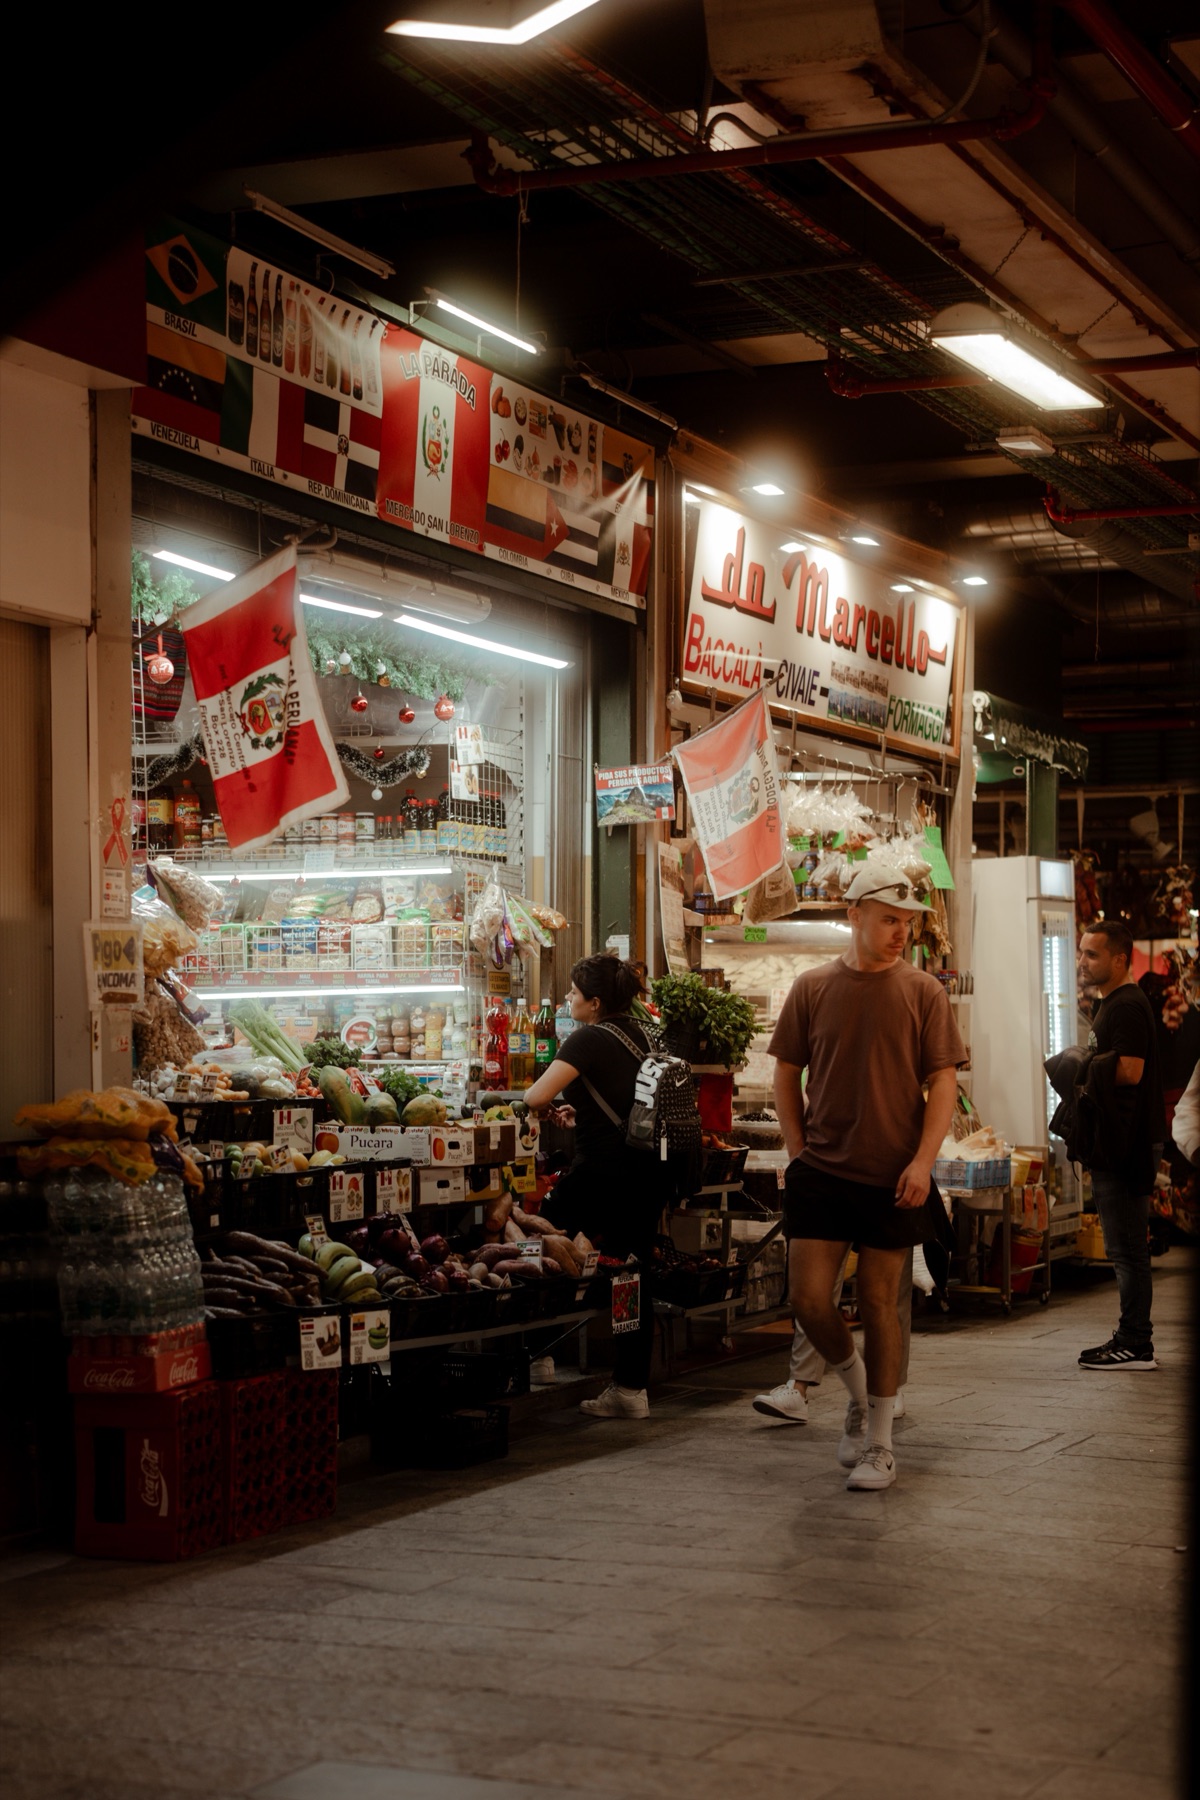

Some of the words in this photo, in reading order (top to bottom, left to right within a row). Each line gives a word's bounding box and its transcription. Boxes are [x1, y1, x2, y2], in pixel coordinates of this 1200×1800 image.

[164, 311, 197, 338] BRASIL
[400, 354, 422, 380] LA
[422, 351, 476, 410] PARADA
[150, 422, 200, 451] VENEZUELA
[250, 459, 275, 480] ITALIA
[308, 480, 323, 497] REP.
[325, 486, 370, 512] DOMINICANA
[385, 498, 426, 528] MERCADO
[427, 515, 444, 534] SAN
[445, 520, 480, 545] LORENZO
[498, 548, 529, 568] COLOMBIA
[560, 569, 575, 584] CUBA
[782, 551, 948, 676] Marcello
[684, 613, 763, 690] BACCALÀ
[775, 659, 820, 706] CIVAIE
[886, 694, 945, 744] FORMAGGI
[211, 714, 219, 735] Box
[216, 738, 226, 759] 228
[598, 772, 614, 780] PIDA
[614, 770, 627, 779] SUS
[628, 765, 671, 777] PRODUCTOS
[608, 777, 642, 788] PERUANOS
[350, 1135, 393, 1150] Pucara
[169, 1356, 199, 1386] Coca-Cola
[140, 1447, 160, 1507] Coca-Cola
